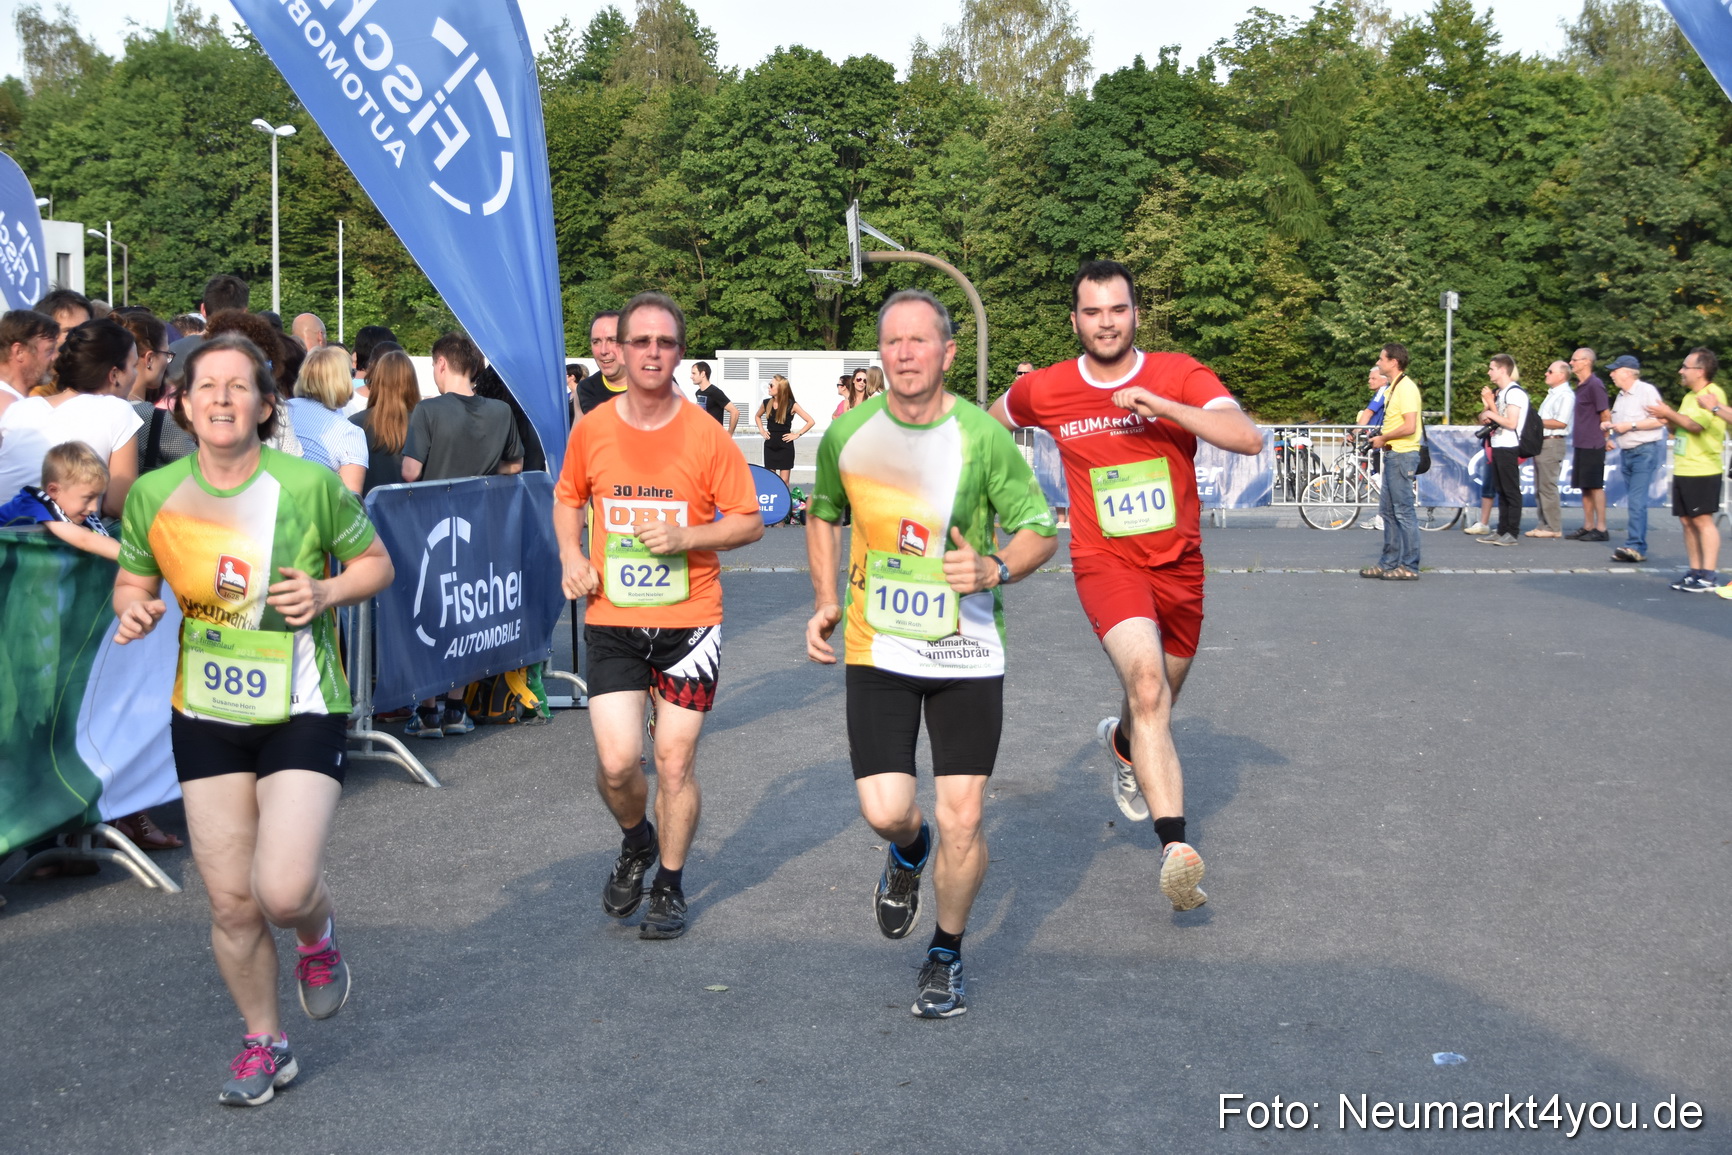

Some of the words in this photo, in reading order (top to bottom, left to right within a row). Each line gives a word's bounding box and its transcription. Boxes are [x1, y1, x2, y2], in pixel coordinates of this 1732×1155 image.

[613, 485, 633, 497] 30
[637, 486, 674, 499] Jahre
[1103, 487, 1166, 518] 1410
[609, 506, 681, 528] OBI
[620, 564, 671, 587] 622
[223, 591, 241, 601] 1628
[875, 585, 946, 618] 1001
[443, 618, 522, 660] AUTOMOBILE
[203, 661, 268, 699] 989
[211, 697, 240, 708] Susanne
[240, 702, 257, 710] Horn
